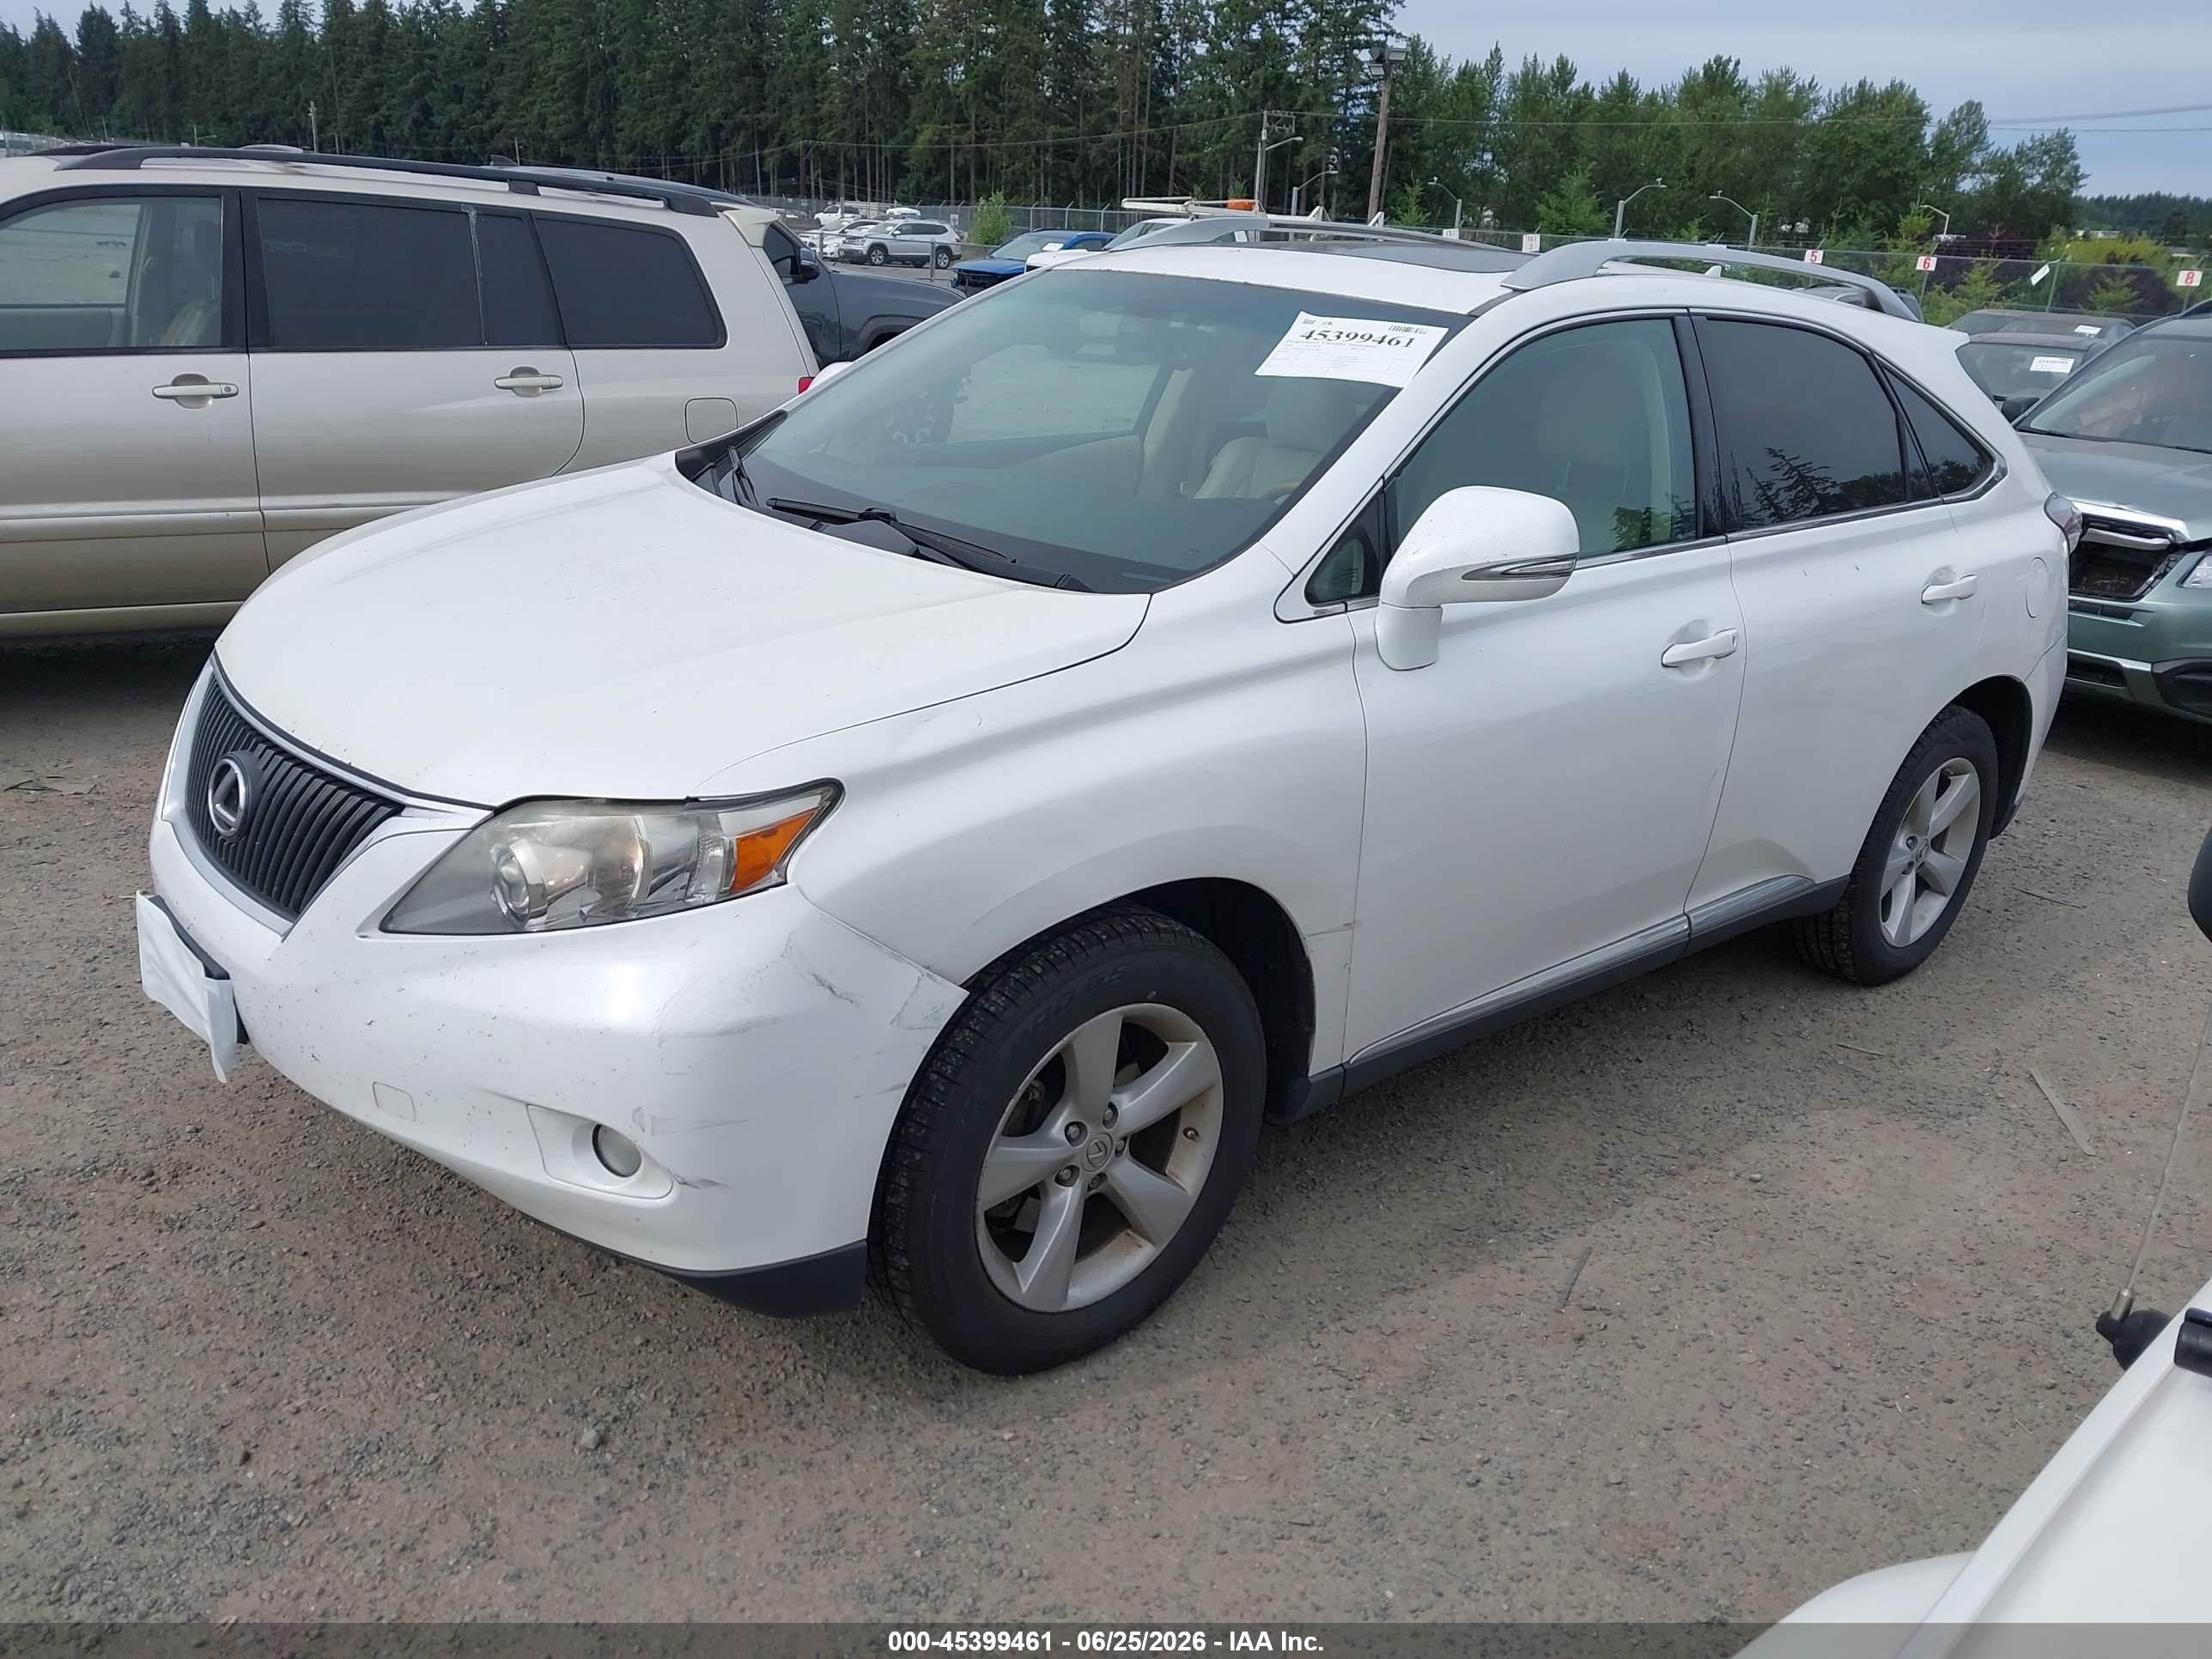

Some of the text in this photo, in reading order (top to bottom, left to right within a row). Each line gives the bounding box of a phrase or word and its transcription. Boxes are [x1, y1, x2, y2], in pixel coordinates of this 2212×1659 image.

[1810, 251, 1818, 262] 5
[1923, 258, 1931, 269] 6
[2185, 272, 2195, 284] 8
[1299, 329, 1415, 348] 45399461
